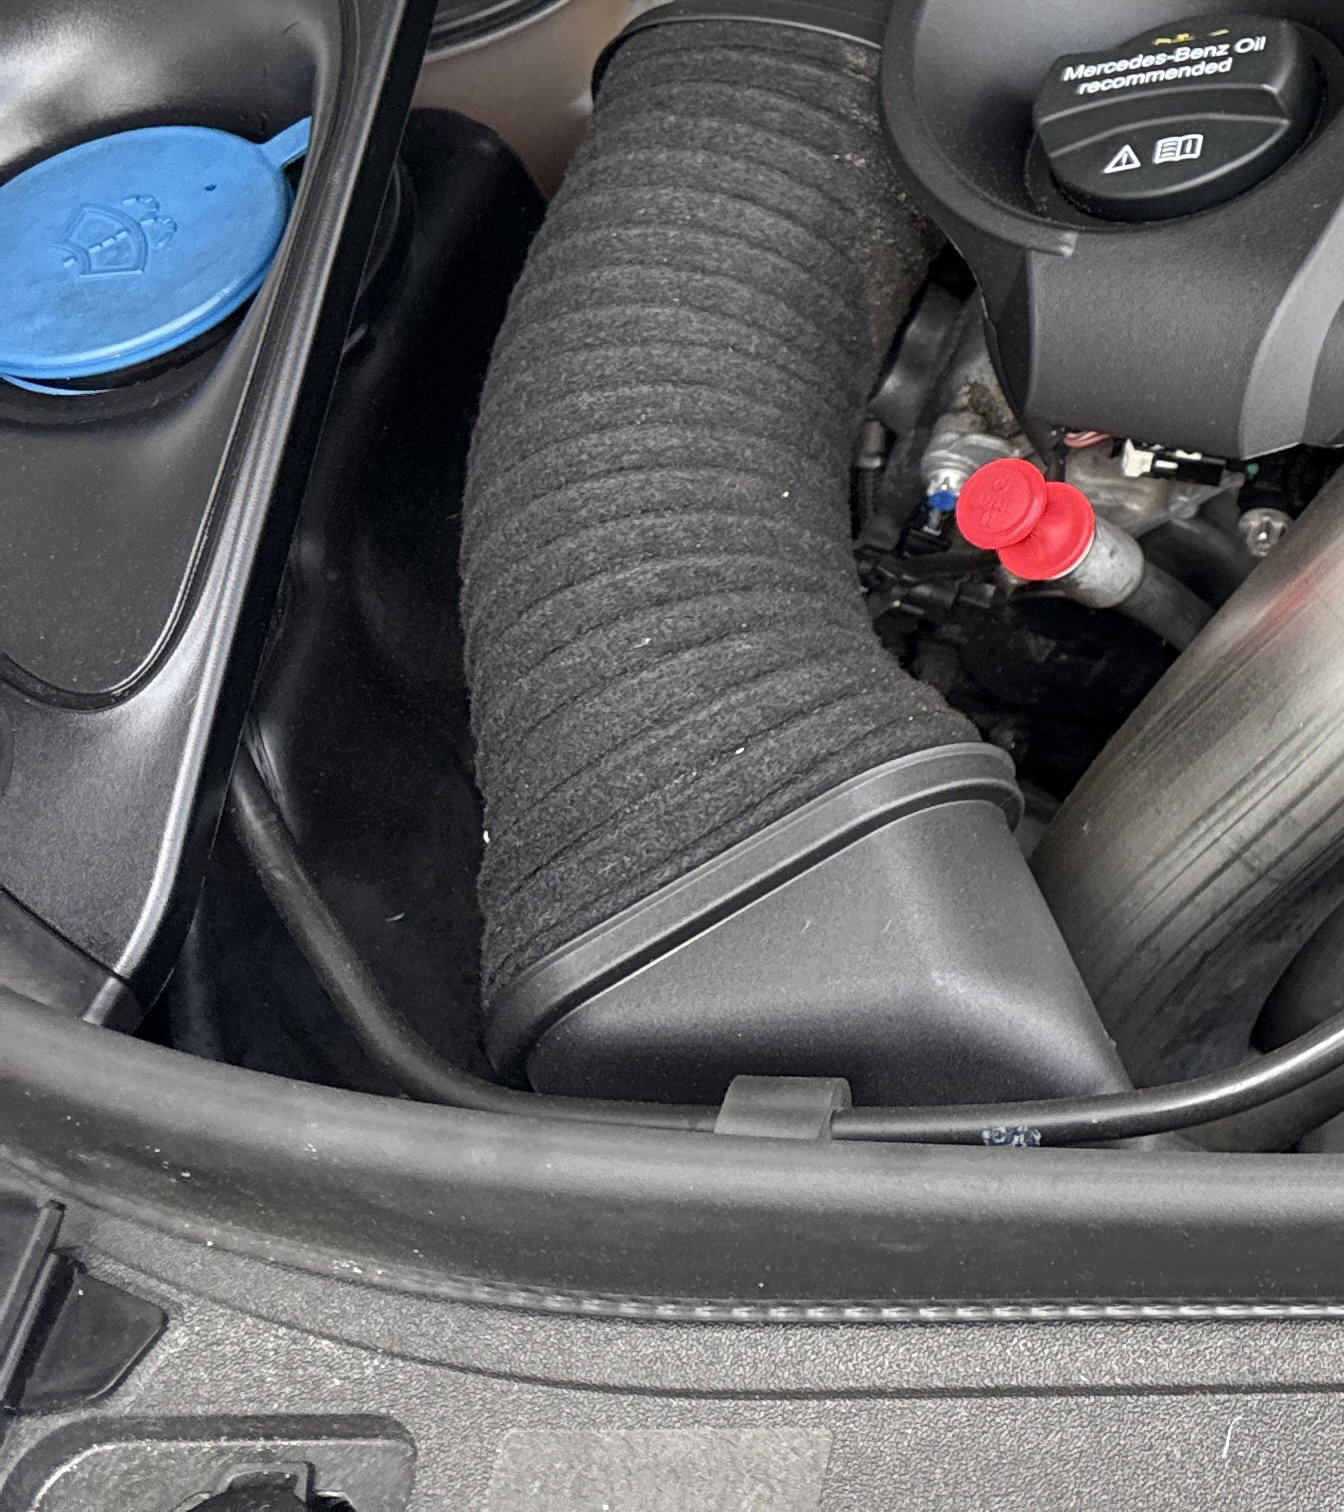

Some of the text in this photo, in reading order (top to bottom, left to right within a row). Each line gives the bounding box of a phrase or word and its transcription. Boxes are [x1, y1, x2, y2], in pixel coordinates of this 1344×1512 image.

[1060, 36, 1267, 81] Mercedes-Benz Oil
[1075, 57, 1233, 95] recommended
